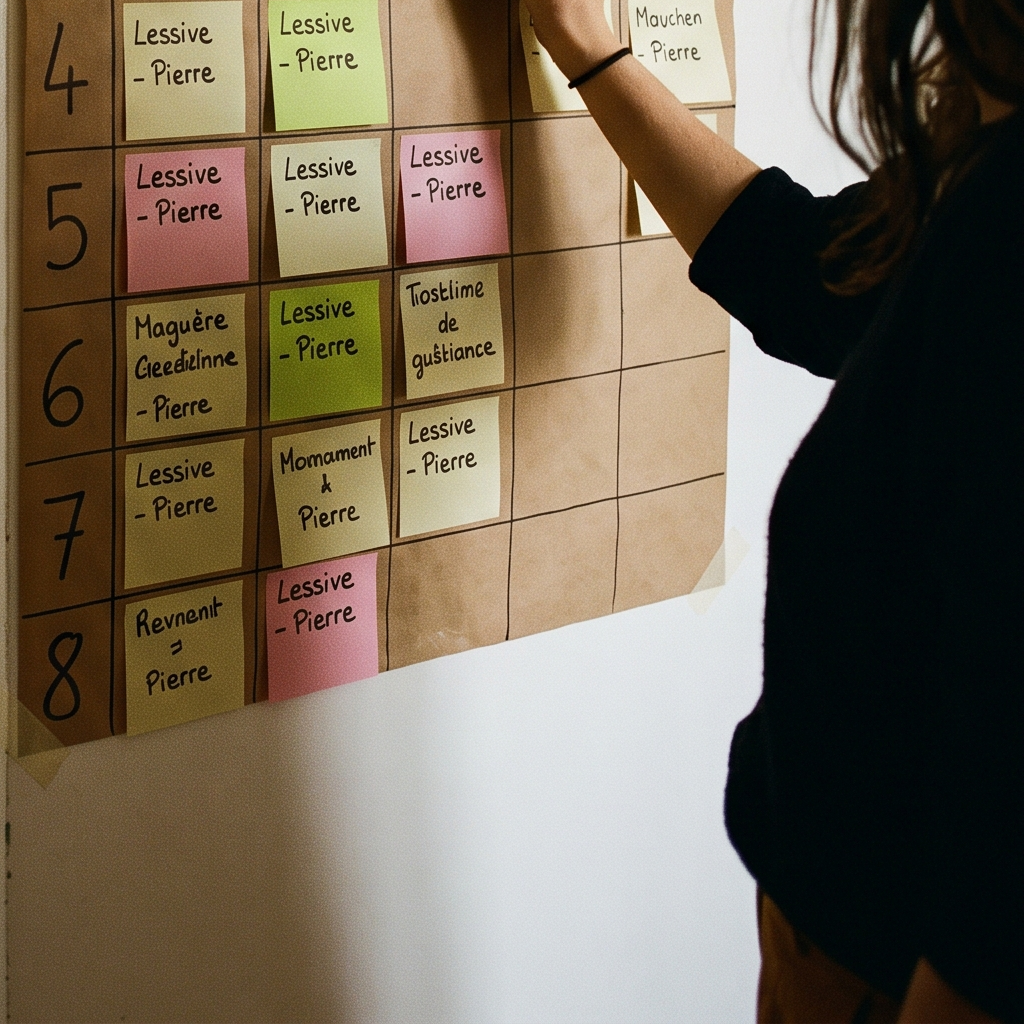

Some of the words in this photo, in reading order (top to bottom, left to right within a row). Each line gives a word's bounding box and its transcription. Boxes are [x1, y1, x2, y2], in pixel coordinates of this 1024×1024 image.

[281, 11, 354, 35] Lessive
[636, 7, 702, 28] Mauchen
[135, 21, 212, 45] Lessive
[296, 48, 358, 72] Pierre
[651, 40, 700, 61] Pierre
[44, 22, 88, 115] 4
[151, 59, 215, 85] Pierre
[285, 157, 356, 181] Lessive
[411, 144, 483, 168] Lessive
[138, 163, 221, 189] Lessive
[427, 178, 485, 202] Pierre
[156, 199, 222, 225] Pierre
[301, 191, 360, 216] Pierre
[47, 183, 87, 270] 5
[281, 298, 354, 325] Lessive
[439, 312, 458, 333] de
[296, 335, 358, 361] Pierre
[43, 339, 83, 427] 6
[153, 395, 212, 422] Pierre
[409, 417, 475, 444] Lessive
[137, 459, 214, 487] Lessive
[422, 452, 477, 475] Pierre
[153, 496, 217, 521] Pierre
[298, 505, 359, 531] Pierre
[44, 491, 85, 580] 7
[277, 571, 355, 604] Lessive
[294, 607, 355, 634] Pierre
[43, 632, 83, 721] 8
[146, 666, 212, 695] Pierre
